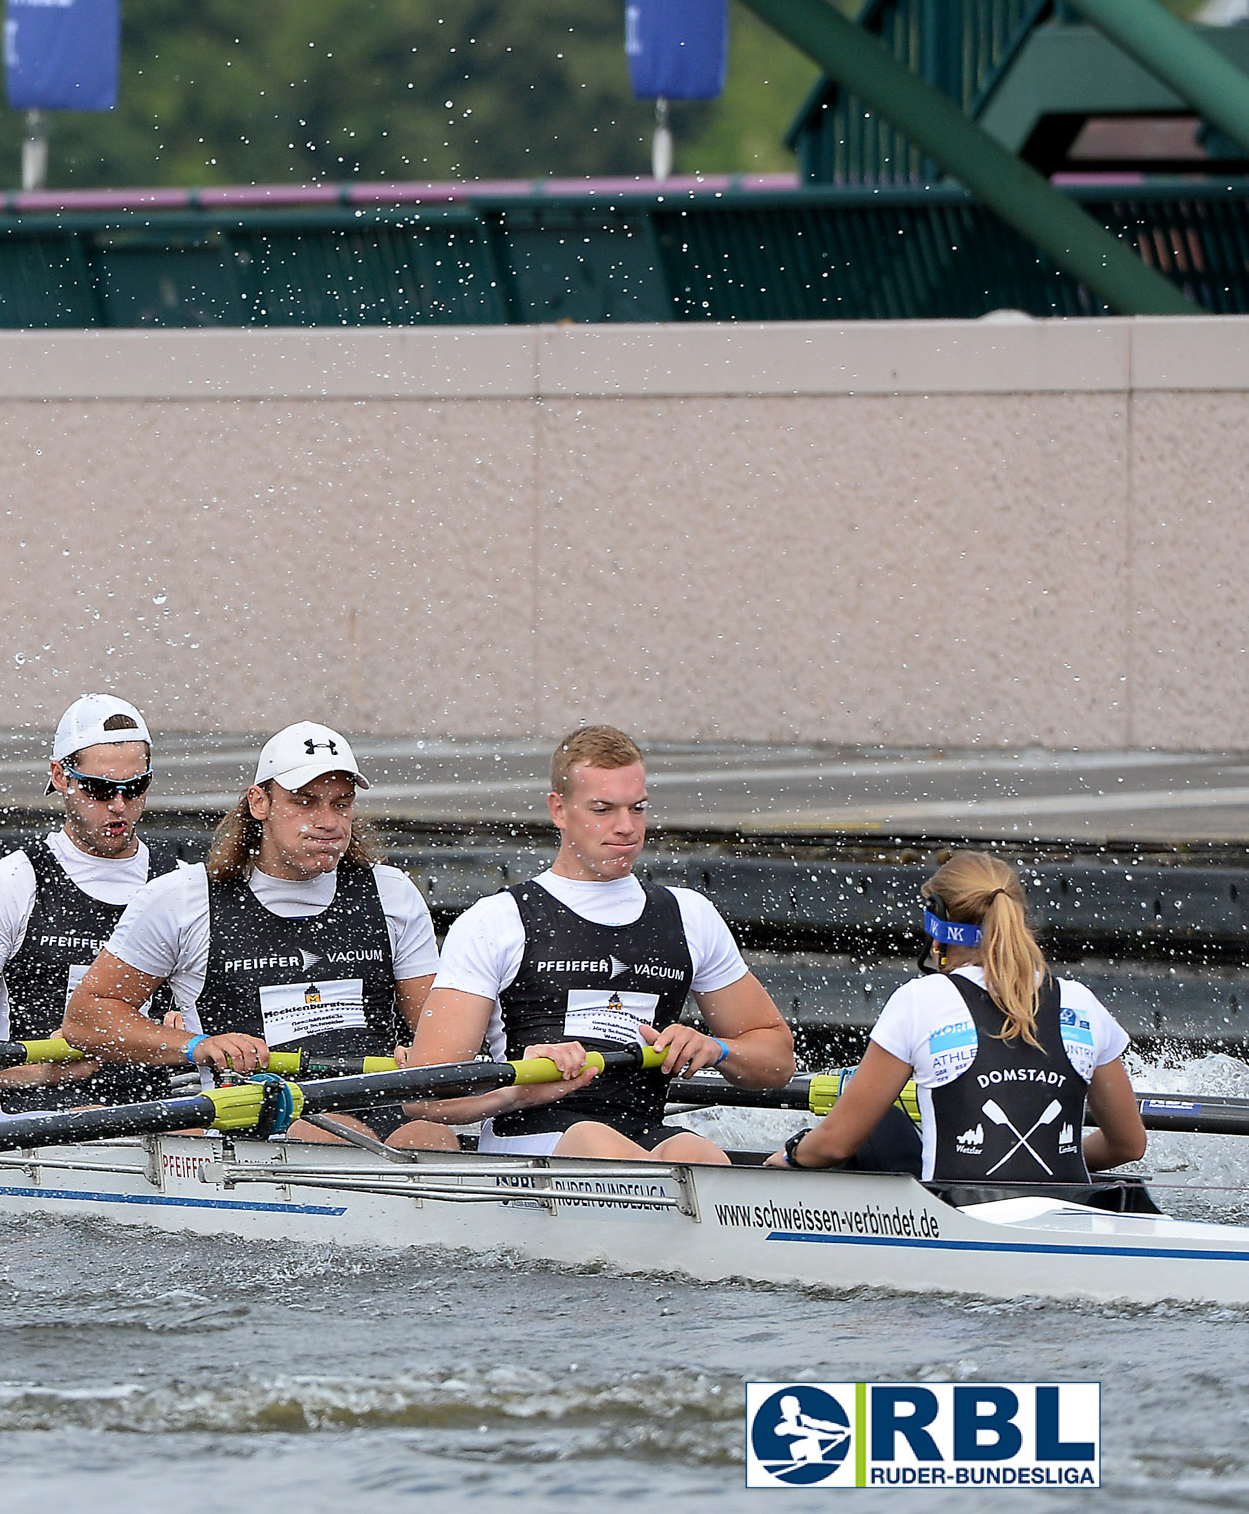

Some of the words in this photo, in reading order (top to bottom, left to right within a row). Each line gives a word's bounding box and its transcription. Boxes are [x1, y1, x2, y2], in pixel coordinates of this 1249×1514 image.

[947, 926, 964, 942] NK
[224, 955, 301, 973] PFEIFFER
[326, 949, 383, 963] VACUUM
[537, 959, 609, 973] PFEIFFER
[633, 963, 685, 981] VACUUM
[977, 1069, 1067, 1089] DOMSTADT
[715, 1199, 940, 1239] www.schweissen-verbindet.de
